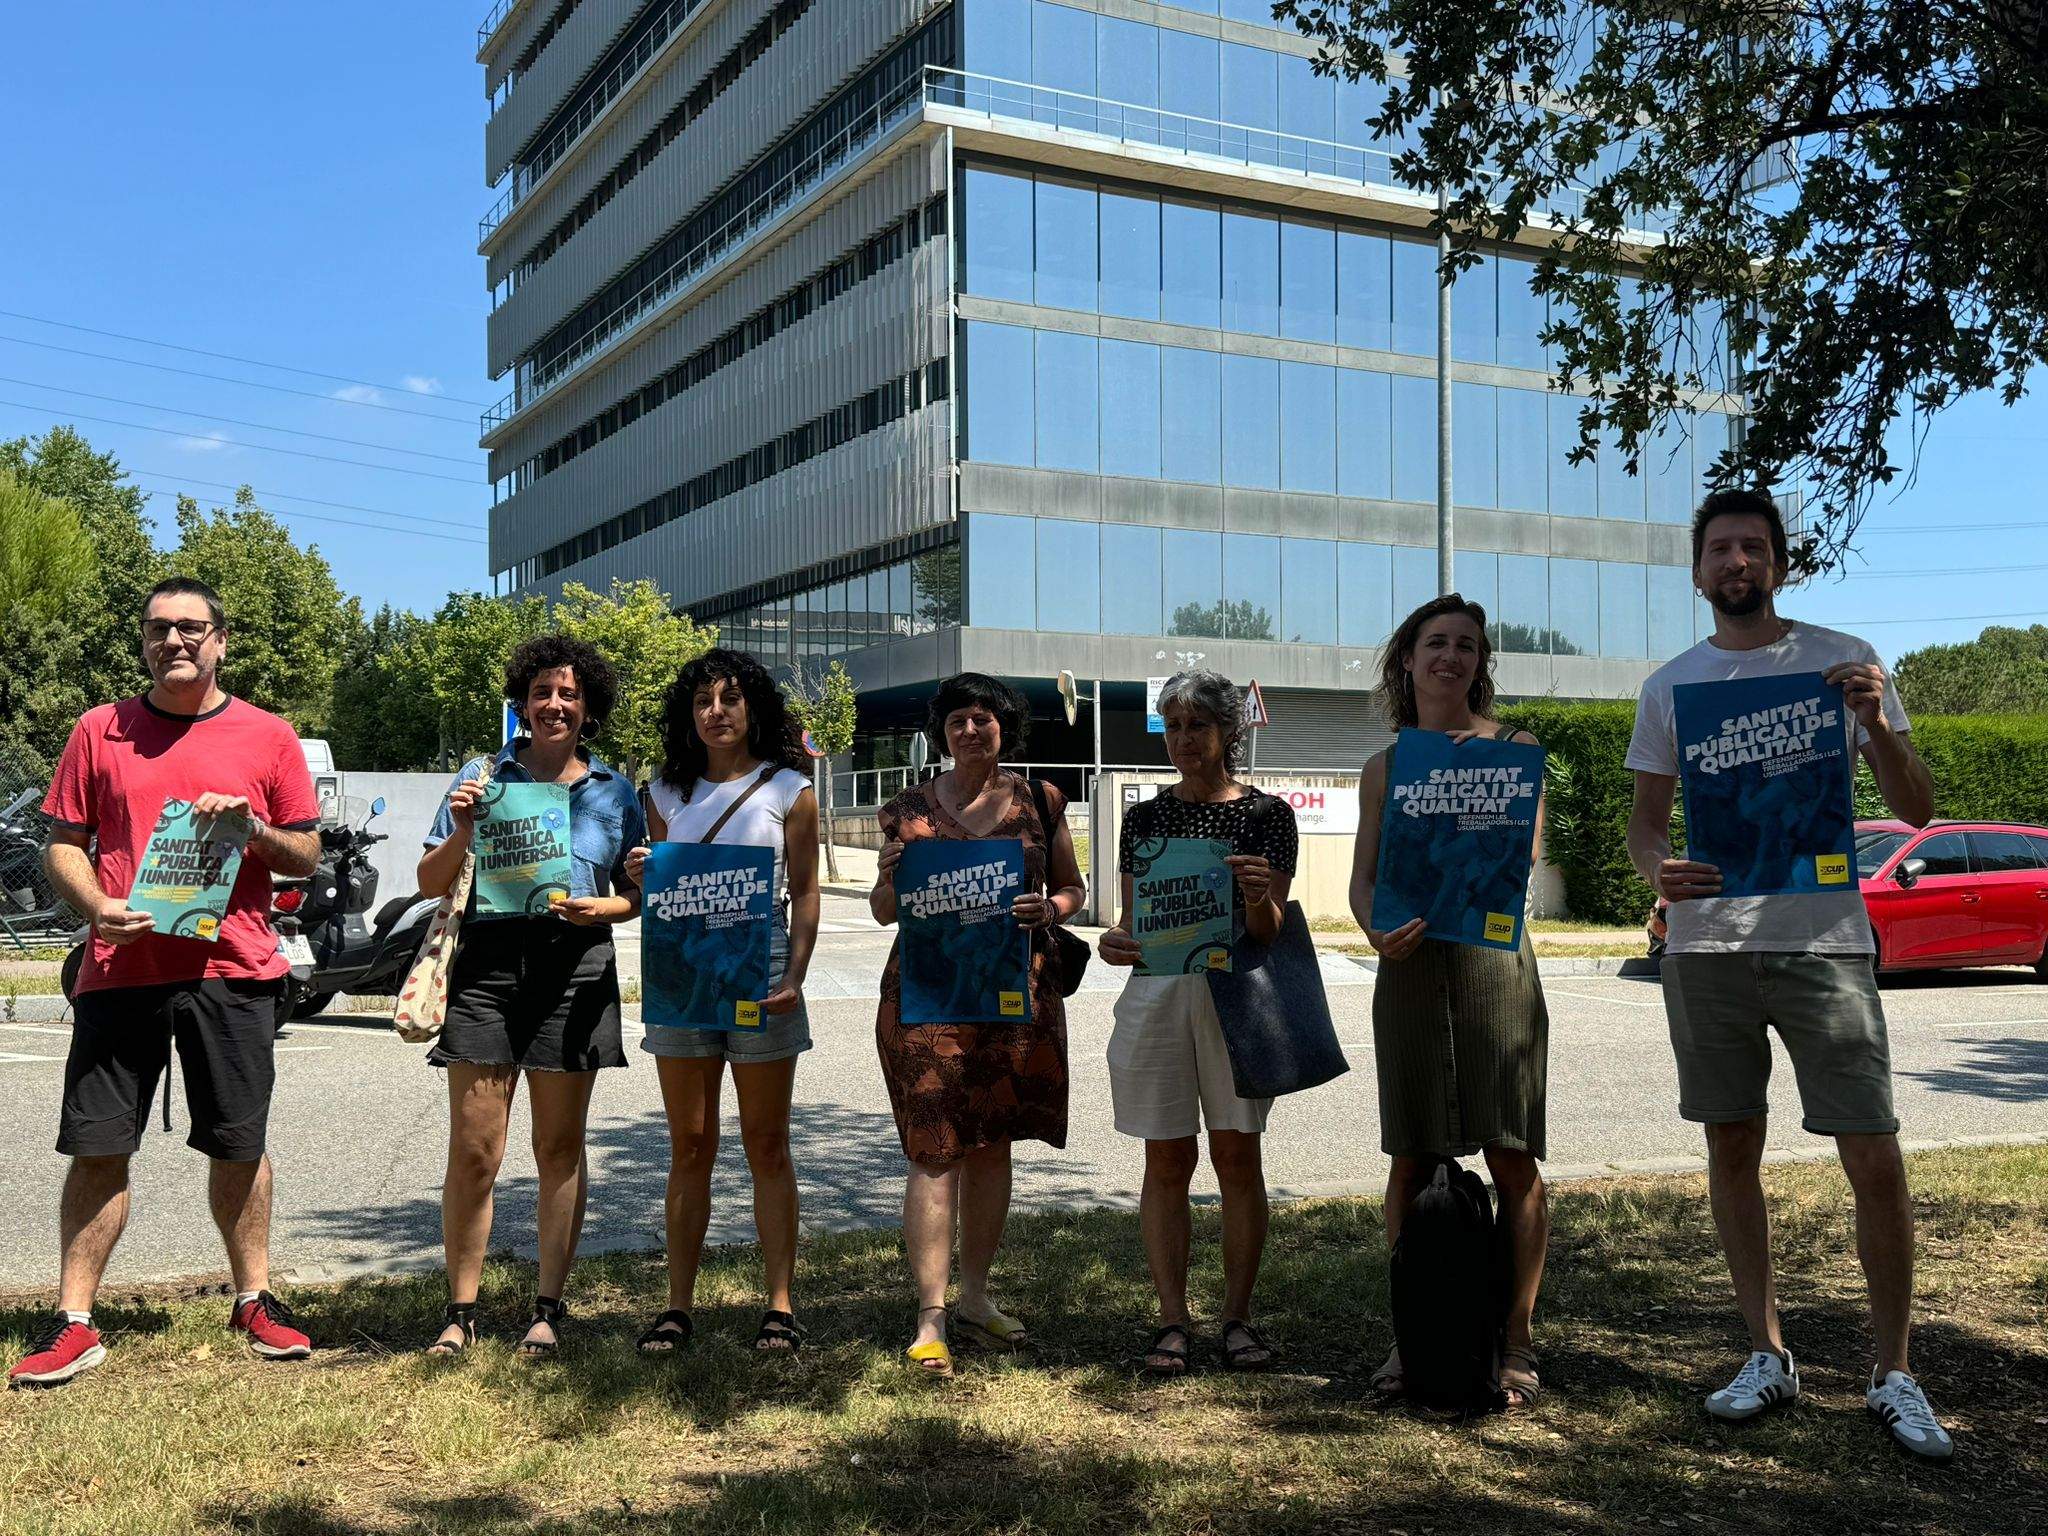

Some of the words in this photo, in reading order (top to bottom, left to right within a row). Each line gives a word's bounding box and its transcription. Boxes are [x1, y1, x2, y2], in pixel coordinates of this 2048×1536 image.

[1721, 697, 1820, 736] SANITAT
[1685, 723, 1790, 761] PÚBLICA
[1793, 719, 1800, 735] I
[1805, 710, 1837, 732] DE
[1700, 732, 1815, 775] QUALITAT
[1428, 767, 1522, 784] SANITAT
[1393, 780, 1488, 800] PÚBLICA
[1491, 783, 1499, 798] I
[1503, 783, 1534, 798] DE
[1402, 798, 1510, 818] QUALITAT
[479, 816, 539, 839] SANITAT
[150, 838, 214, 854] SANITAT
[481, 856, 486, 870] I
[487, 843, 567, 870] UNIVERSAL
[146, 869, 230, 887] UNIVERSAL
[677, 867, 758, 889] SANITAT
[927, 860, 1006, 889] SANITAT
[1138, 875, 1200, 899] SANITAT
[647, 885, 731, 907] PÚBLICA
[733, 883, 739, 897] I
[743, 880, 768, 896] DE
[900, 881, 981, 907] PÚBLICA
[983, 878, 989, 891] I
[993, 872, 1019, 890] DE
[657, 896, 750, 921] QUALITAT
[911, 890, 1001, 919] QUALITAT
[1138, 917, 1143, 933] I
[1144, 902, 1229, 932] UNIVERSAL
